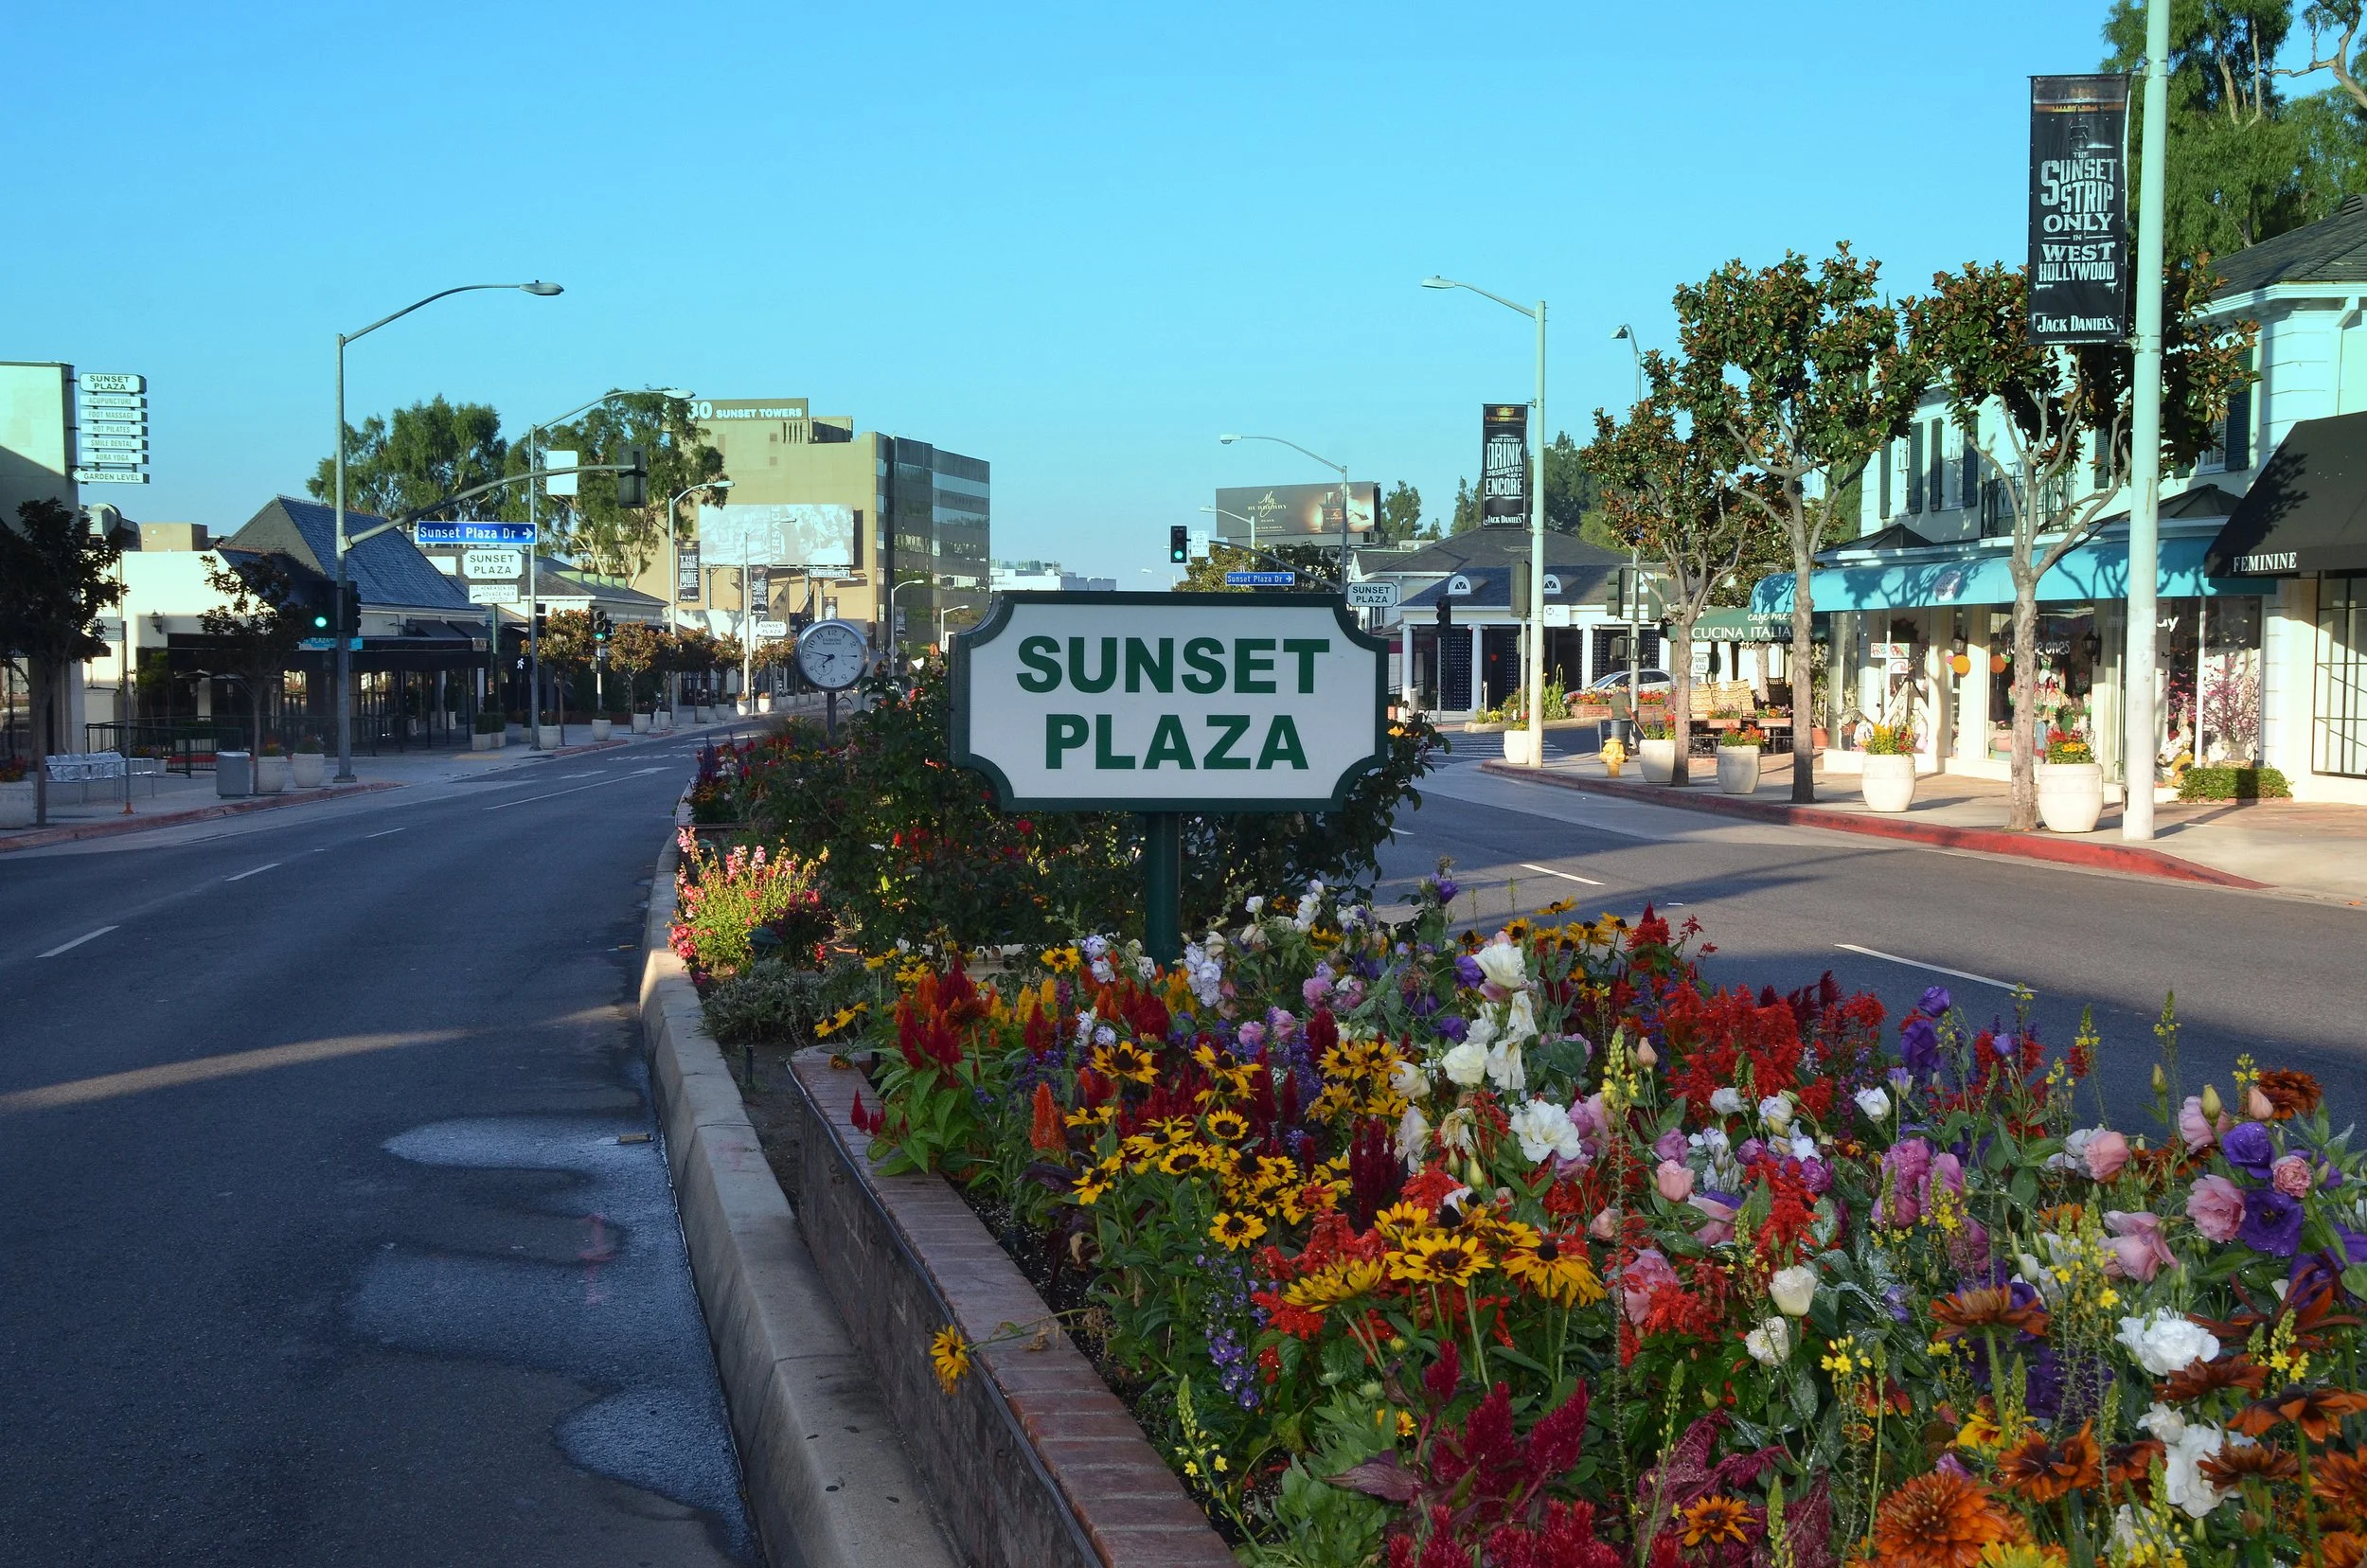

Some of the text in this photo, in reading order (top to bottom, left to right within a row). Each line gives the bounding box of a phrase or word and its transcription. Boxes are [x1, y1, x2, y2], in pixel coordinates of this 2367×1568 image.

[2040, 158, 2117, 205] SUNSET
[2060, 181, 2114, 213] STRIP
[2043, 213, 2114, 233] ONLY
[2041, 241, 2116, 261] WEST
[2038, 261, 2115, 281] HOLLYWOOD
[2037, 314, 2114, 332] JACK DANIEL'S
[716, 408, 757, 419] SUNSET
[758, 407, 803, 418] TOWERS
[1486, 442, 1522, 470] DRINK
[1486, 466, 1523, 476] DESERVES
[1486, 478, 1522, 495] ENCORE
[1486, 514, 1500, 524] JACK
[419, 526, 516, 539] Sunset Plaza Dr
[2233, 552, 2297, 572] FEMININE
[680, 572, 698, 584] INDIE
[1747, 613, 1770, 625] cafe
[1691, 626, 1804, 639] CUCINA ITALIA
[2045, 641, 2070, 655] ones
[1016, 635, 1330, 695] SUNSET
[1045, 714, 1309, 770] PLAZA
